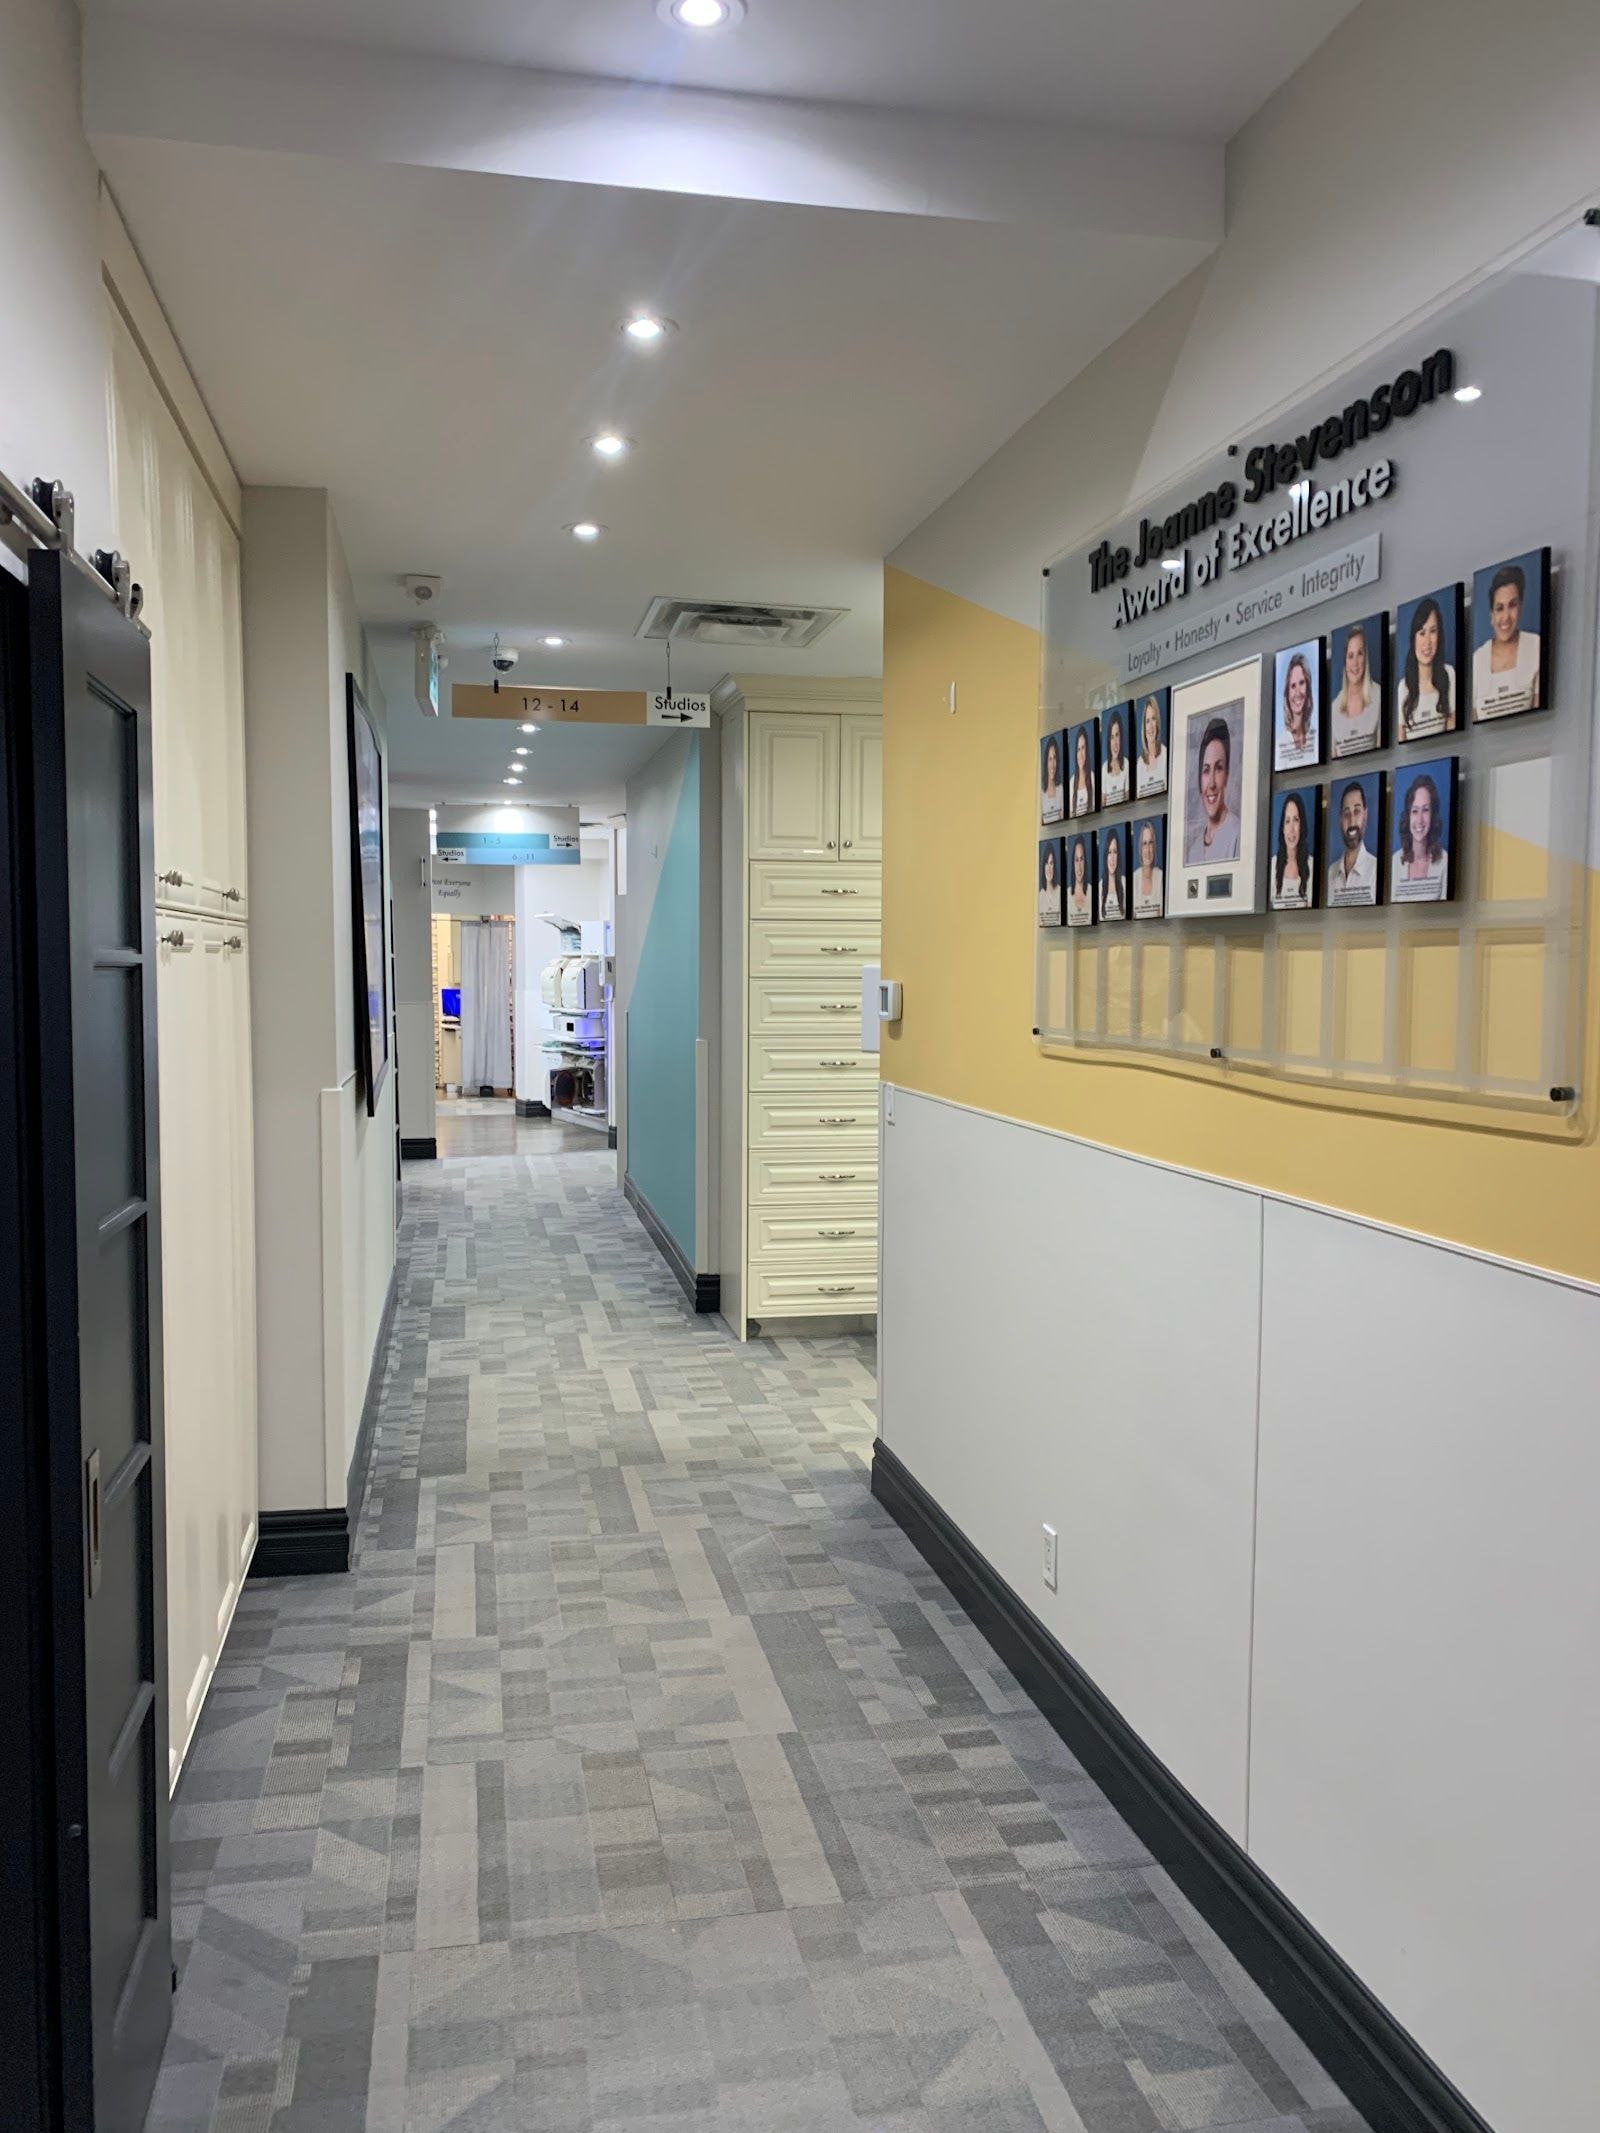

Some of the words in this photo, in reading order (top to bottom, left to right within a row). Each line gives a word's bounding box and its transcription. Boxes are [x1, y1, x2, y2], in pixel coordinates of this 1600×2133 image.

[1088, 540, 1130, 594] The
[1133, 480, 1239, 569] Joanne
[1243, 347, 1456, 503] Stevenson
[1112, 549, 1190, 629] Award
[1194, 528, 1224, 588] of
[1227, 457, 1394, 572] Excellence
[1128, 641, 1162, 672] Loyalty
[1174, 614, 1221, 652] Honesty
[1235, 590, 1283, 625] Service
[1301, 553, 1366, 598] Integrity
[522, 697, 541, 711] 12
[560, 698, 580, 713] 14
[654, 695, 706, 712] Studios
[553, 834, 580, 843] Studios
[437, 849, 465, 857] Studios
